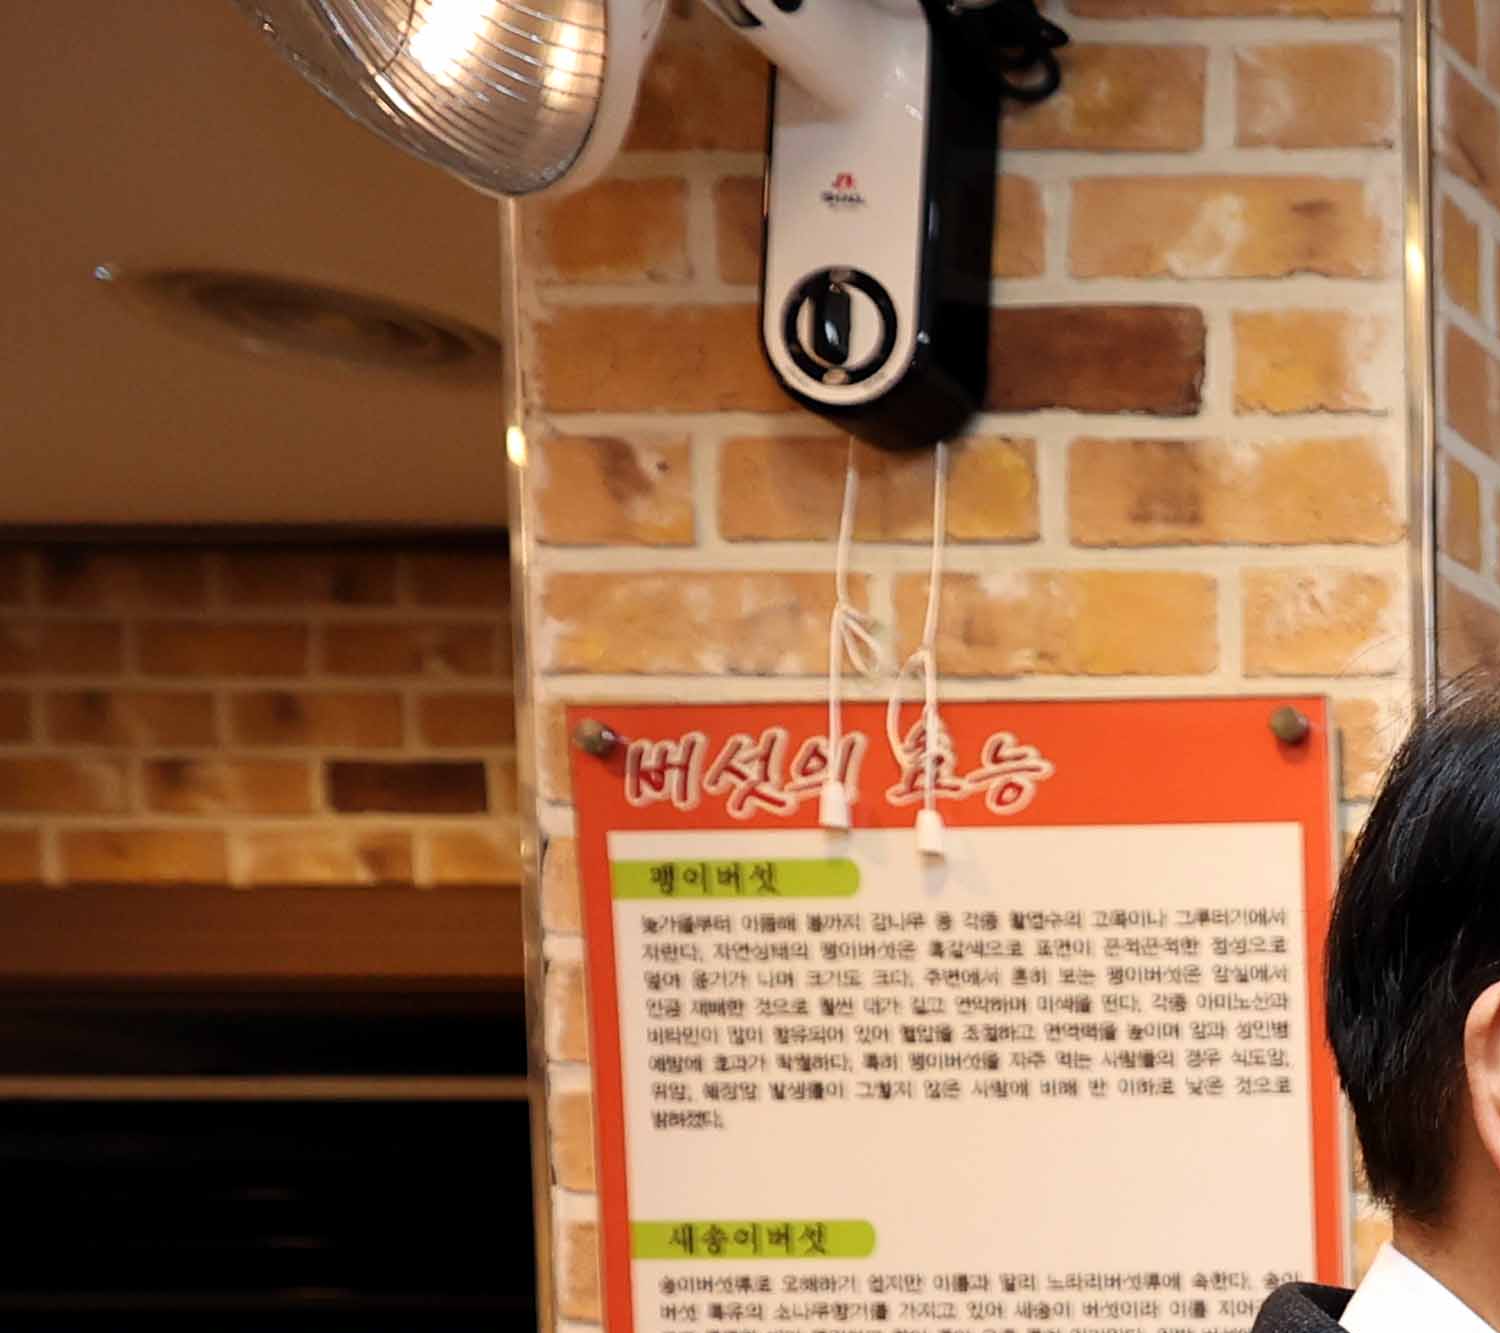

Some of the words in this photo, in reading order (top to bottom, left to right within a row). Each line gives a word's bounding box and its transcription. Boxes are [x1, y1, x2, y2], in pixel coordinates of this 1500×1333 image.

[626, 727, 868, 818] 버섯의
[886, 716, 1055, 815] 효능
[650, 862, 779, 896] 팽이버섯
[668, 1221, 827, 1256] 새송이버섯
